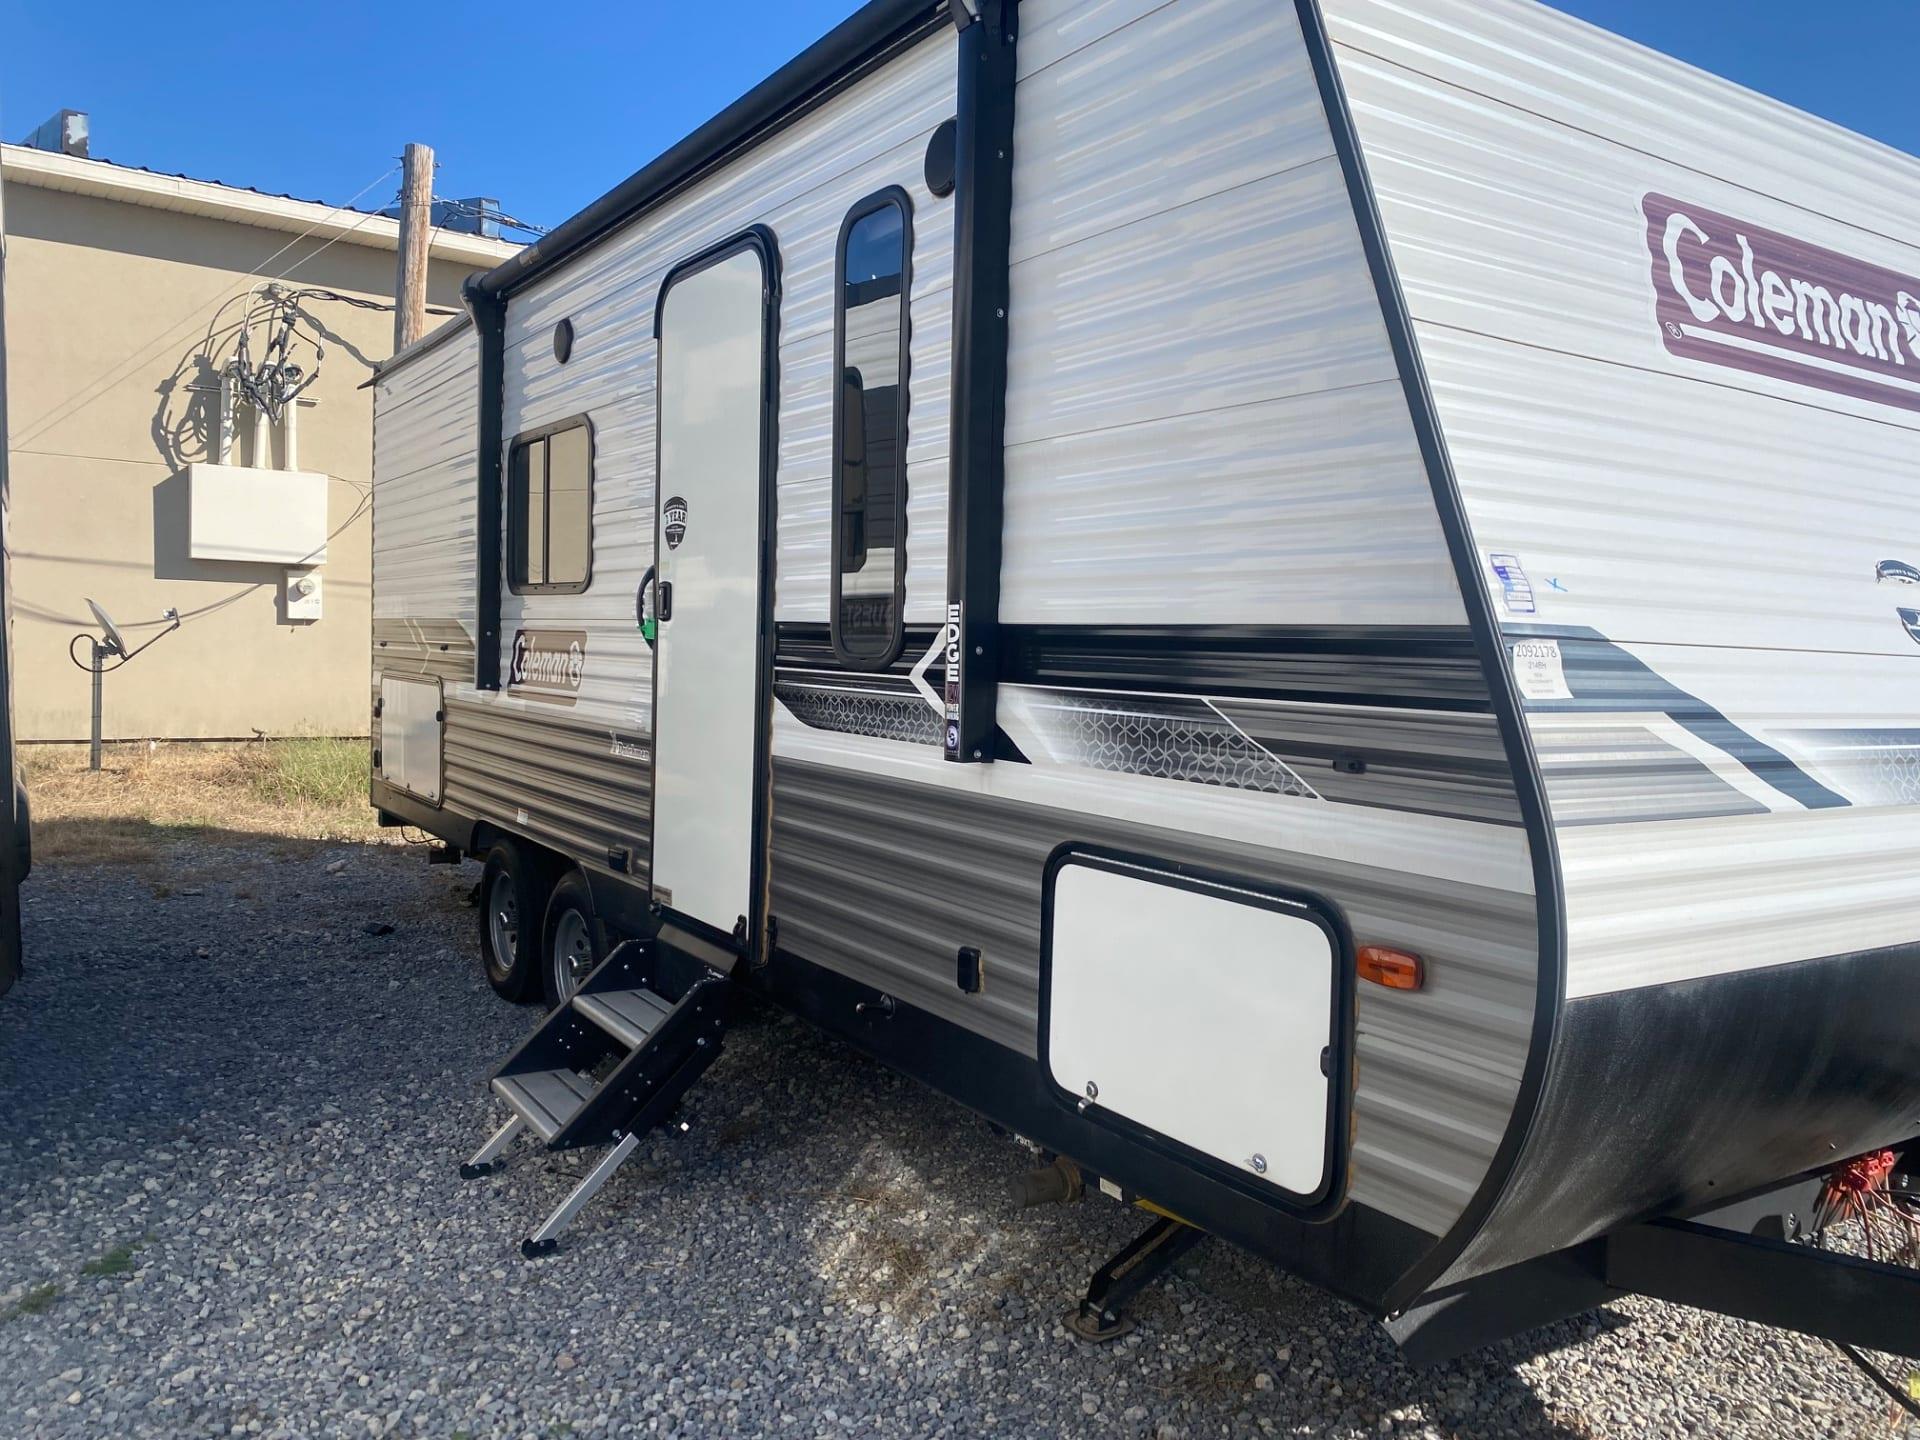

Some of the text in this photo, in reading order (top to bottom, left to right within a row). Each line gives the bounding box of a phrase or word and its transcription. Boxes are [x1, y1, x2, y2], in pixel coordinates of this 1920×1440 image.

[1662, 212, 1905, 366] Coleman
[669, 510, 686, 523] YEAR
[513, 634, 569, 684] Coleman
[947, 604, 960, 682] EDGE
[1516, 644, 1557, 658] 2092178
